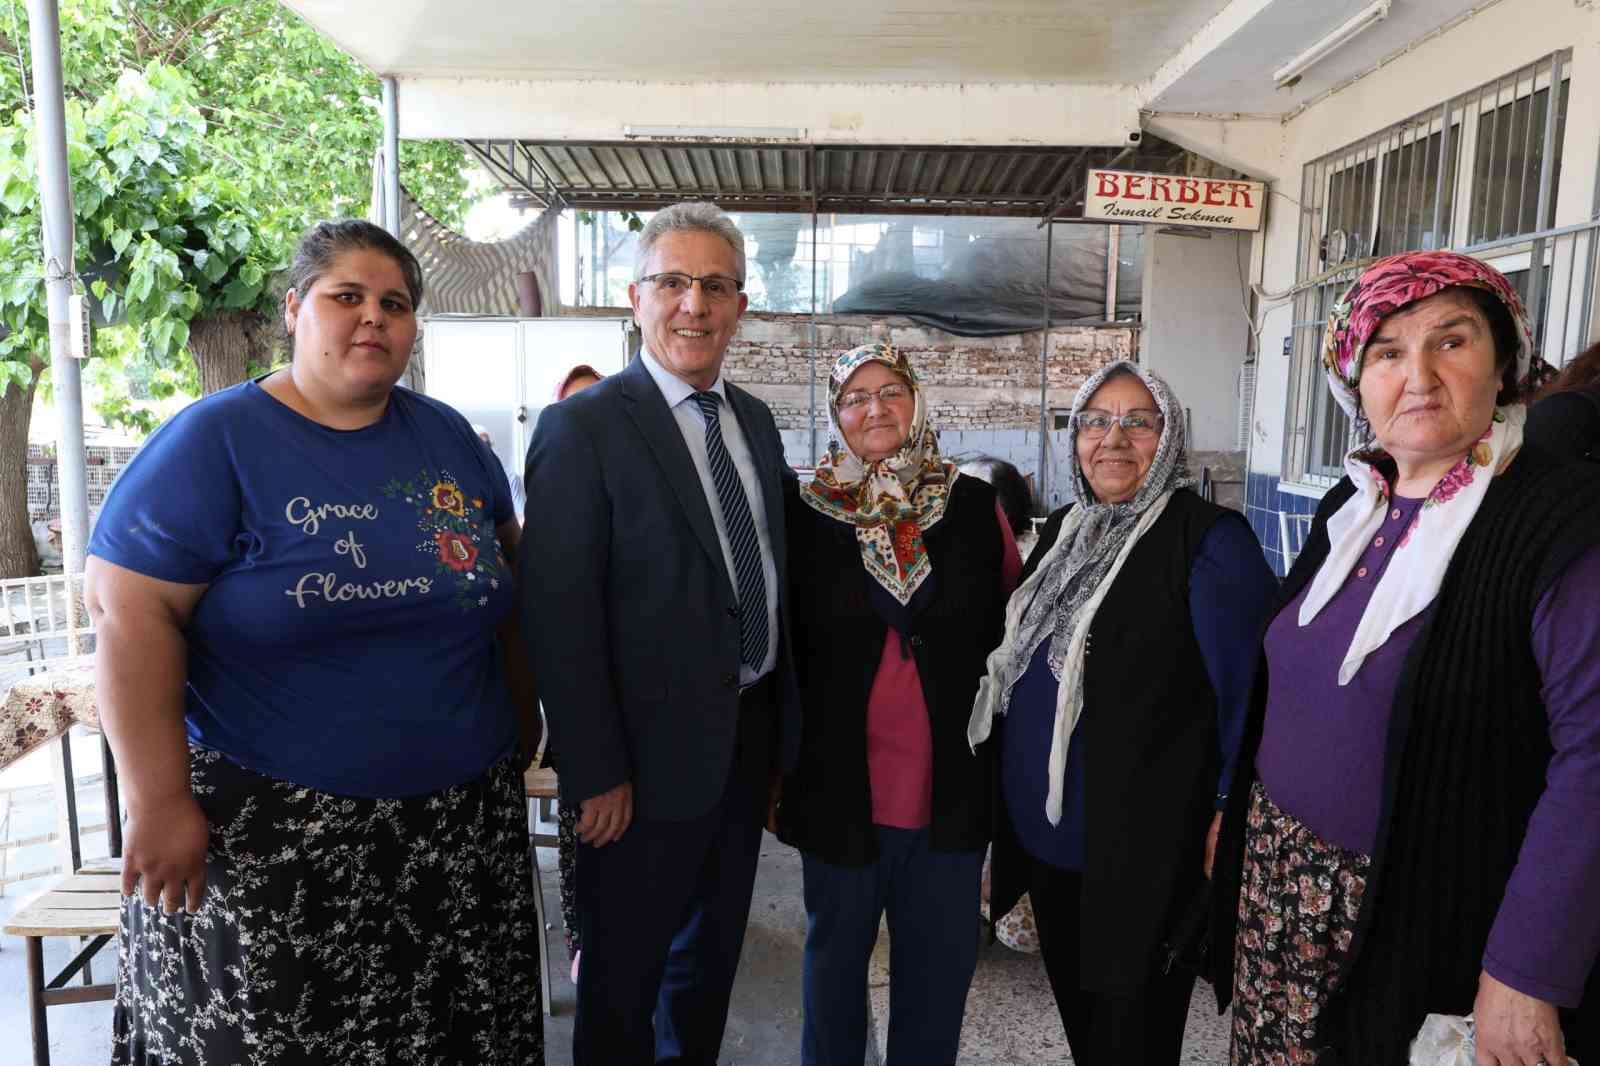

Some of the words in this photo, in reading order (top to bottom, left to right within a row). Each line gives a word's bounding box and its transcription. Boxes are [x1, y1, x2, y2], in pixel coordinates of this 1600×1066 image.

[1095, 172, 1254, 208] BERBER
[1167, 207, 1235, 224] Sekmen
[285, 496, 379, 535] Grace
[333, 531, 367, 568] of
[285, 572, 434, 608] Flowers
